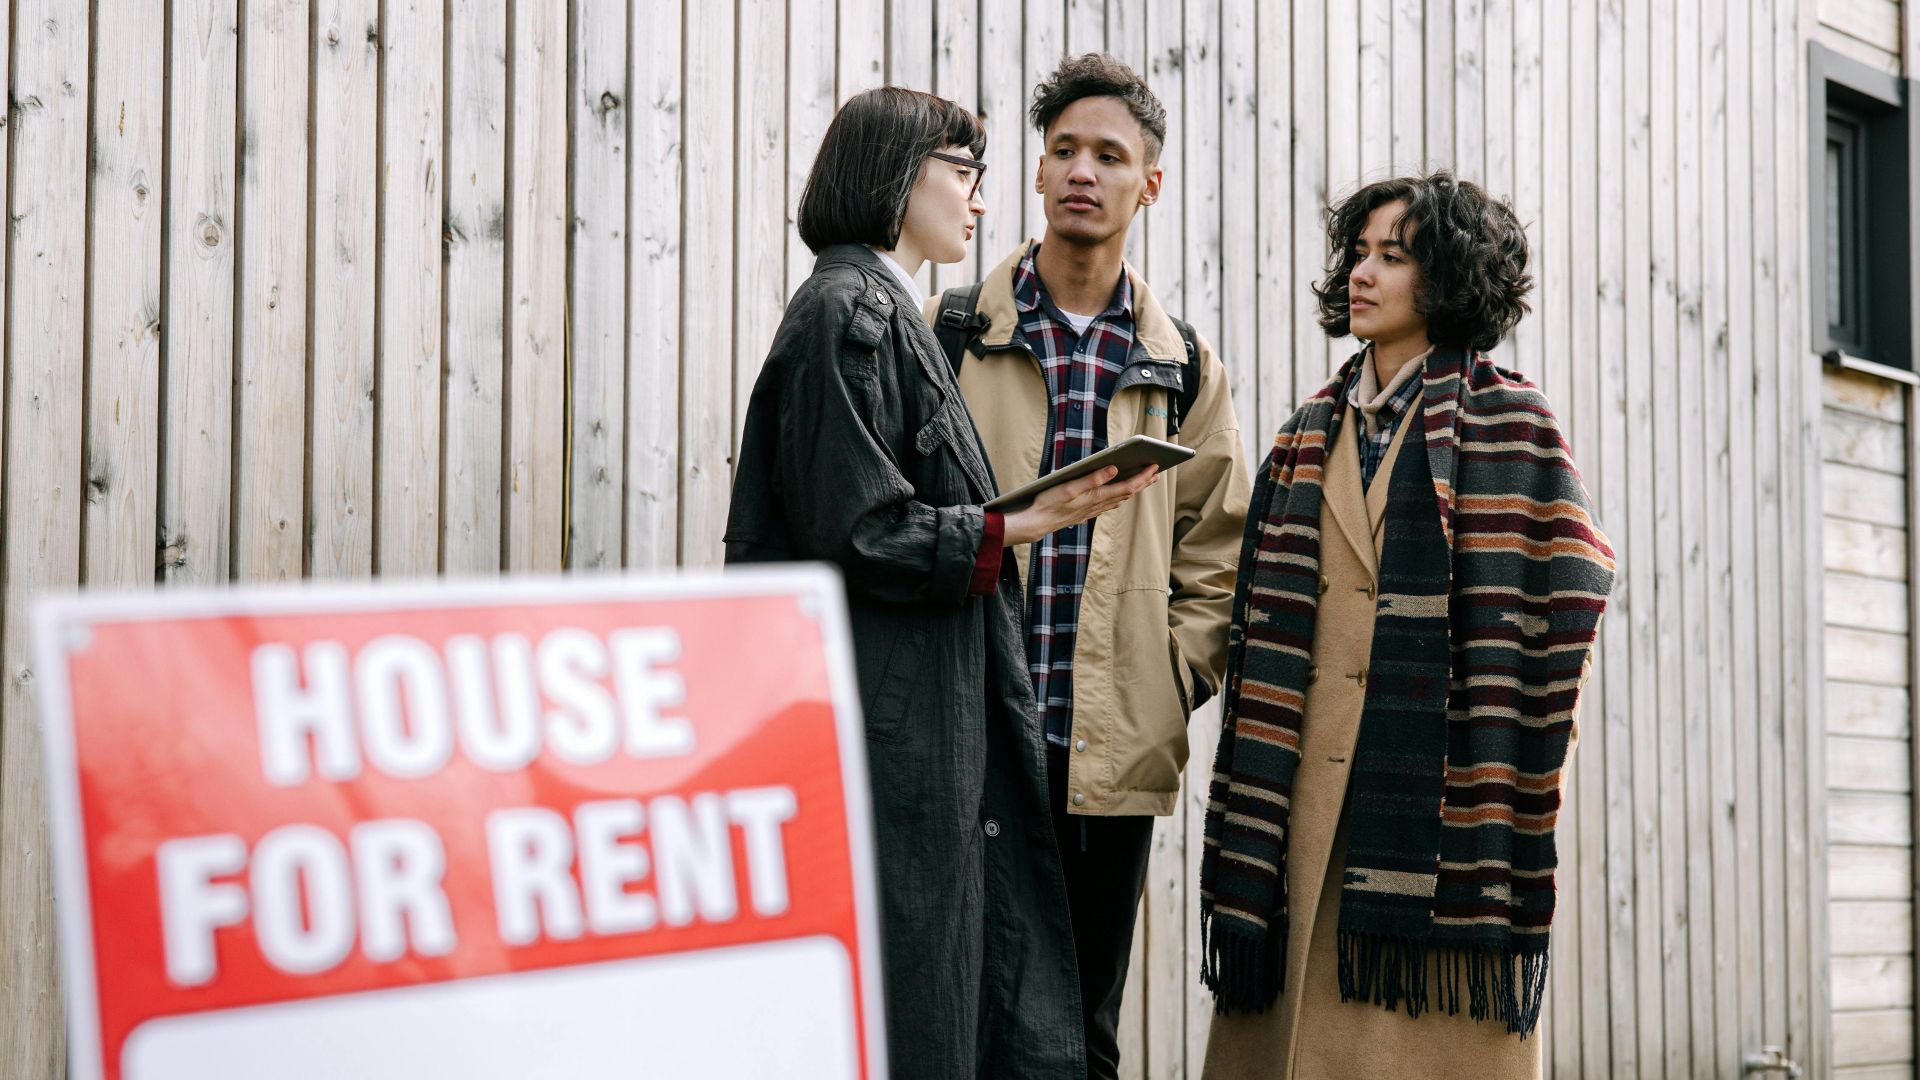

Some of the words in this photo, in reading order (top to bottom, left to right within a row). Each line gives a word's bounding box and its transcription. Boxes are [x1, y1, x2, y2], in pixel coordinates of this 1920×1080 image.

[252, 628, 694, 785] HOUSE
[159, 822, 456, 984] FOR
[486, 786, 796, 944] RENT
